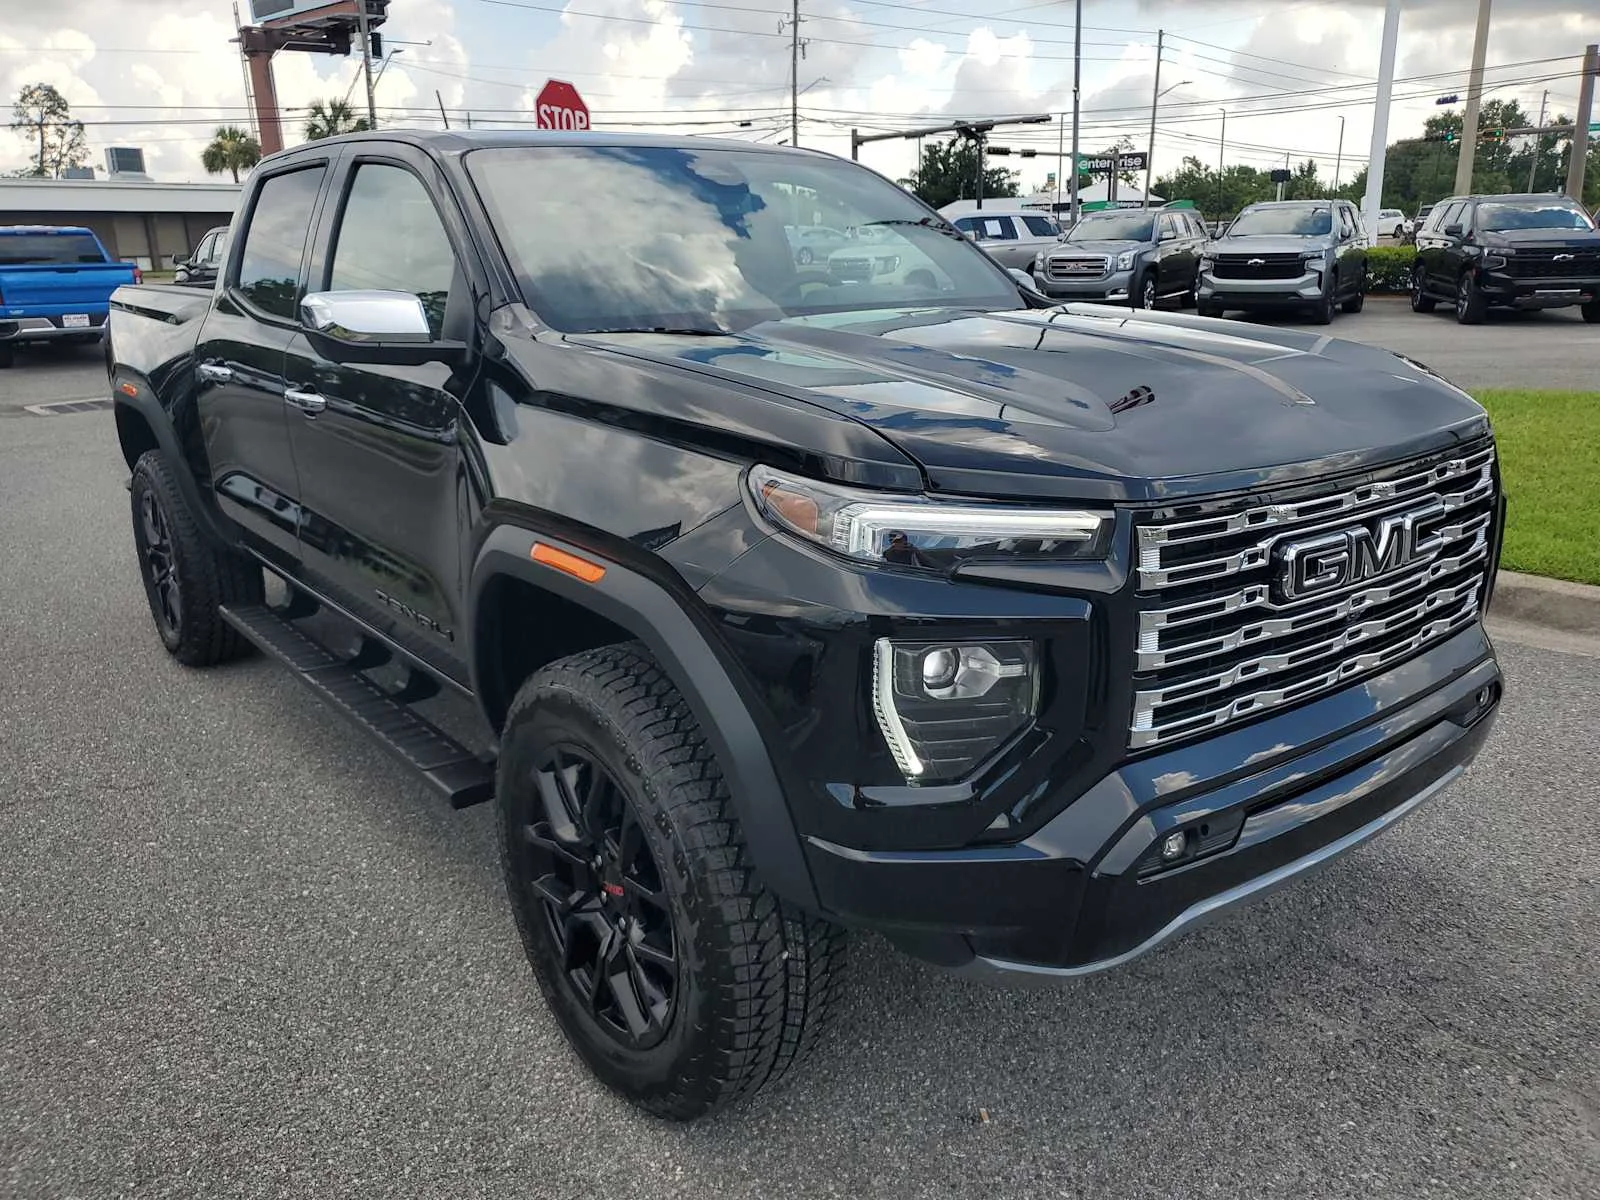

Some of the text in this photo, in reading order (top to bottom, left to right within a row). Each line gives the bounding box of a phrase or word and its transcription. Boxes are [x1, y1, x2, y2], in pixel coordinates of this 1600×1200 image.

[539, 103, 588, 130] STOP
[1078, 155, 1143, 170] enterrise
[1284, 502, 1447, 600] GMC
